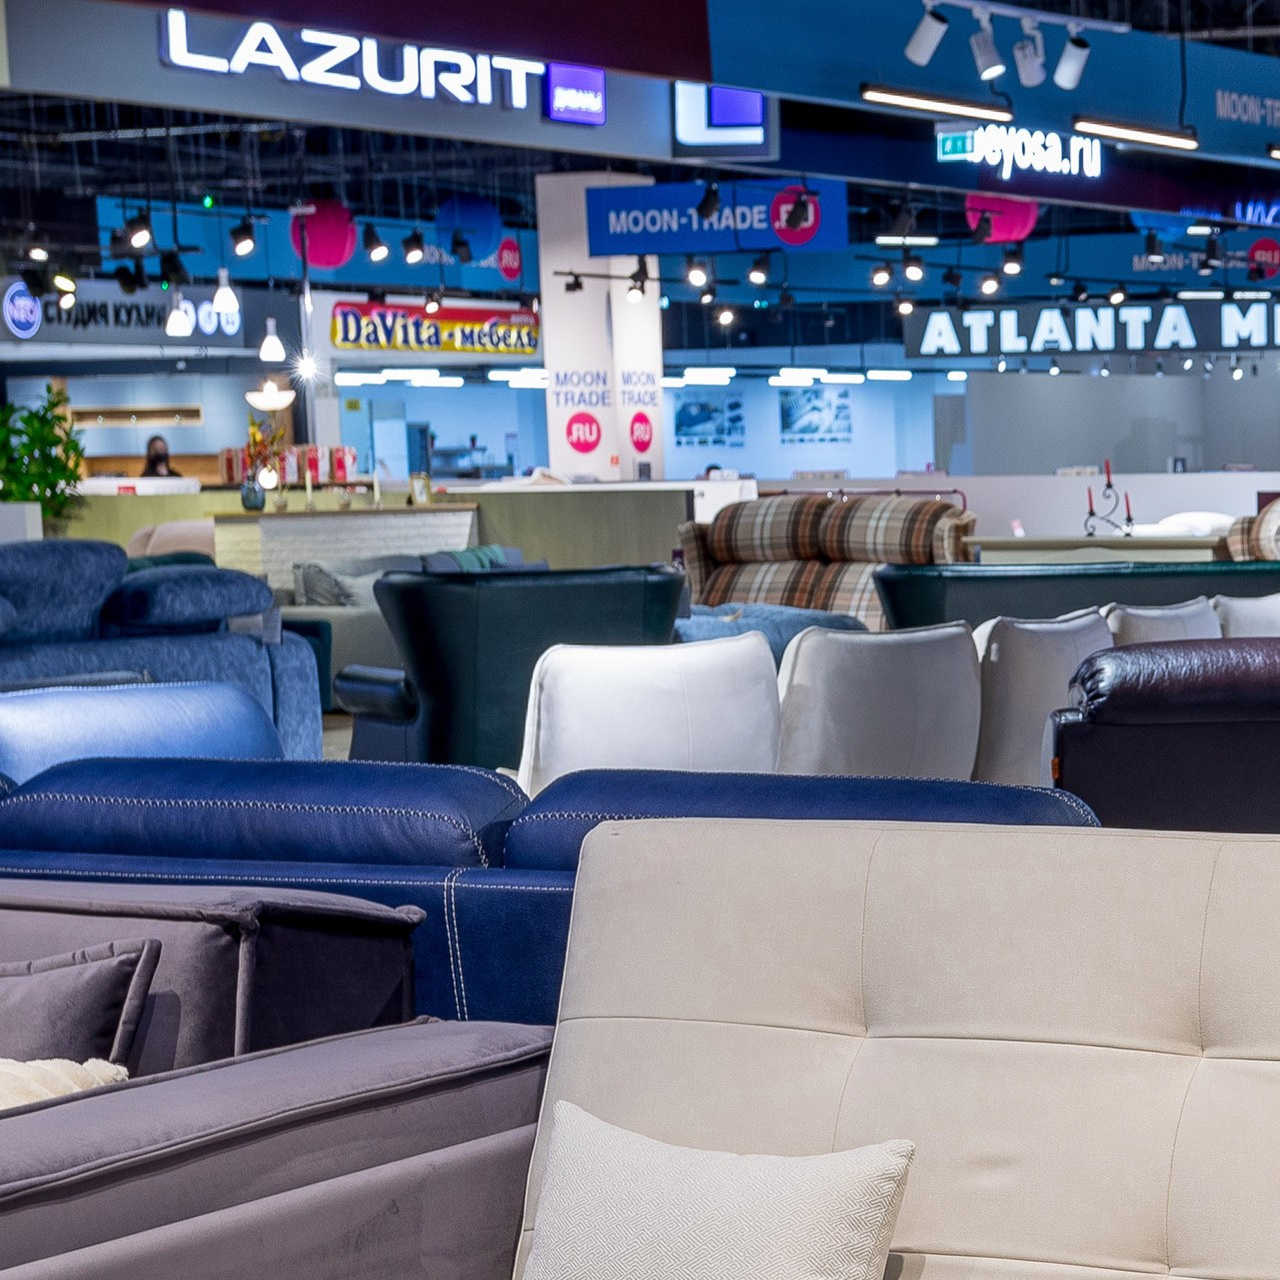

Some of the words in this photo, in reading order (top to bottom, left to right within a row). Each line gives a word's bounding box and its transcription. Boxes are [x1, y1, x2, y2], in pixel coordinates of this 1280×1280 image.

[168, 8, 546, 110] LAZURIT
[336, 308, 440, 349] DaVita
[457, 316, 538, 352] мебель
[919, 303, 1198, 355] ATLANTA
[555, 371, 607, 387] MOON
[621, 371, 656, 386] MOON
[554, 391, 611, 407] TRADE
